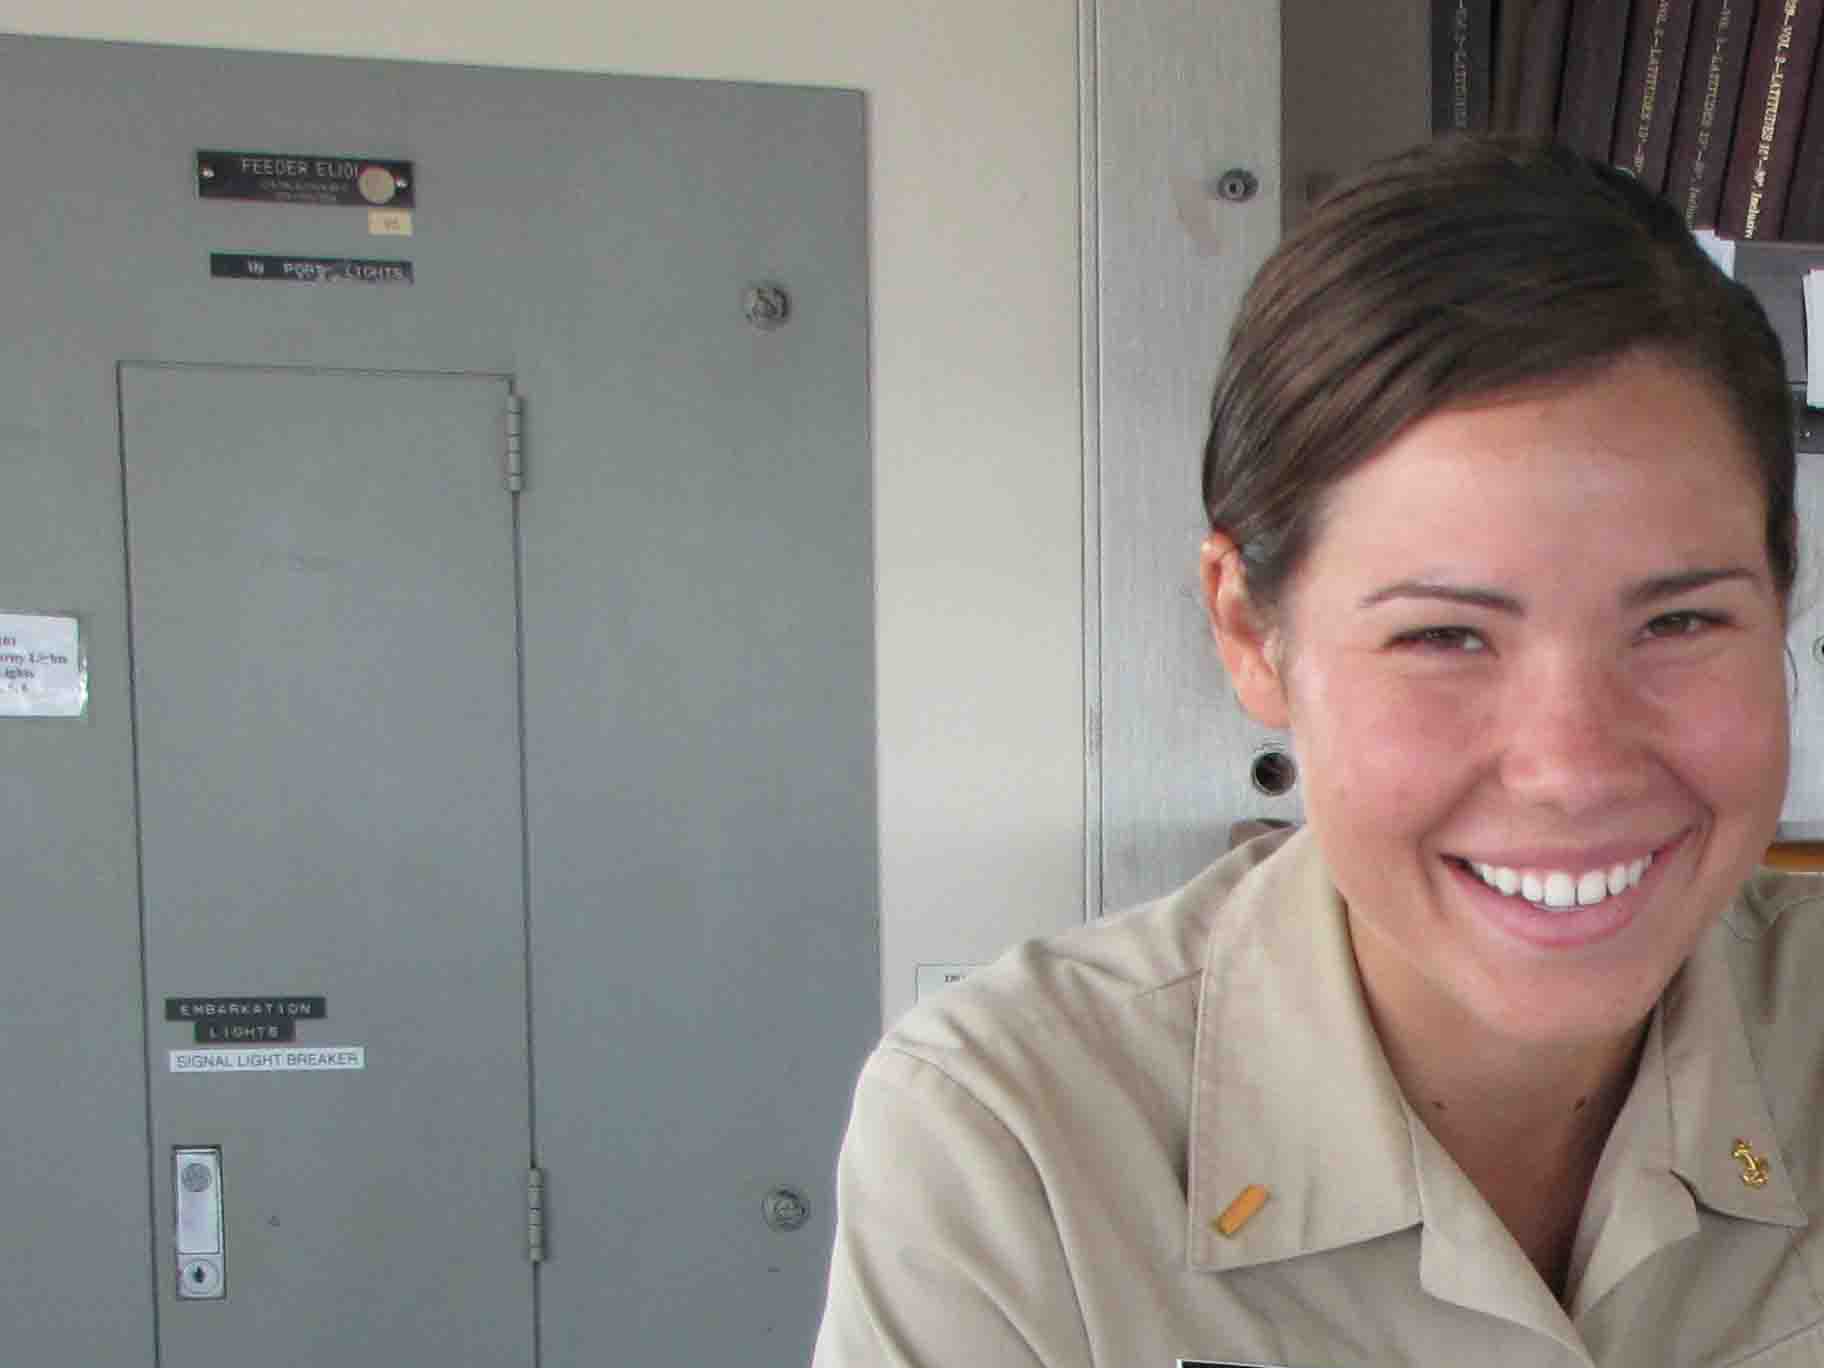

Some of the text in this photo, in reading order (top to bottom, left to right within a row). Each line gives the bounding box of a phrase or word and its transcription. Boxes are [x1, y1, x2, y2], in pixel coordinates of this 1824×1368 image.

[240, 158, 308, 176] FEEDER
[248, 260, 264, 274] IN
[346, 264, 404, 281] LIGHTS
[180, 1003, 311, 1017] EMBARKATION
[209, 1026, 279, 1039] LIGHTS
[176, 1052, 358, 1068] SIGNAL LIGHT BREAKER
